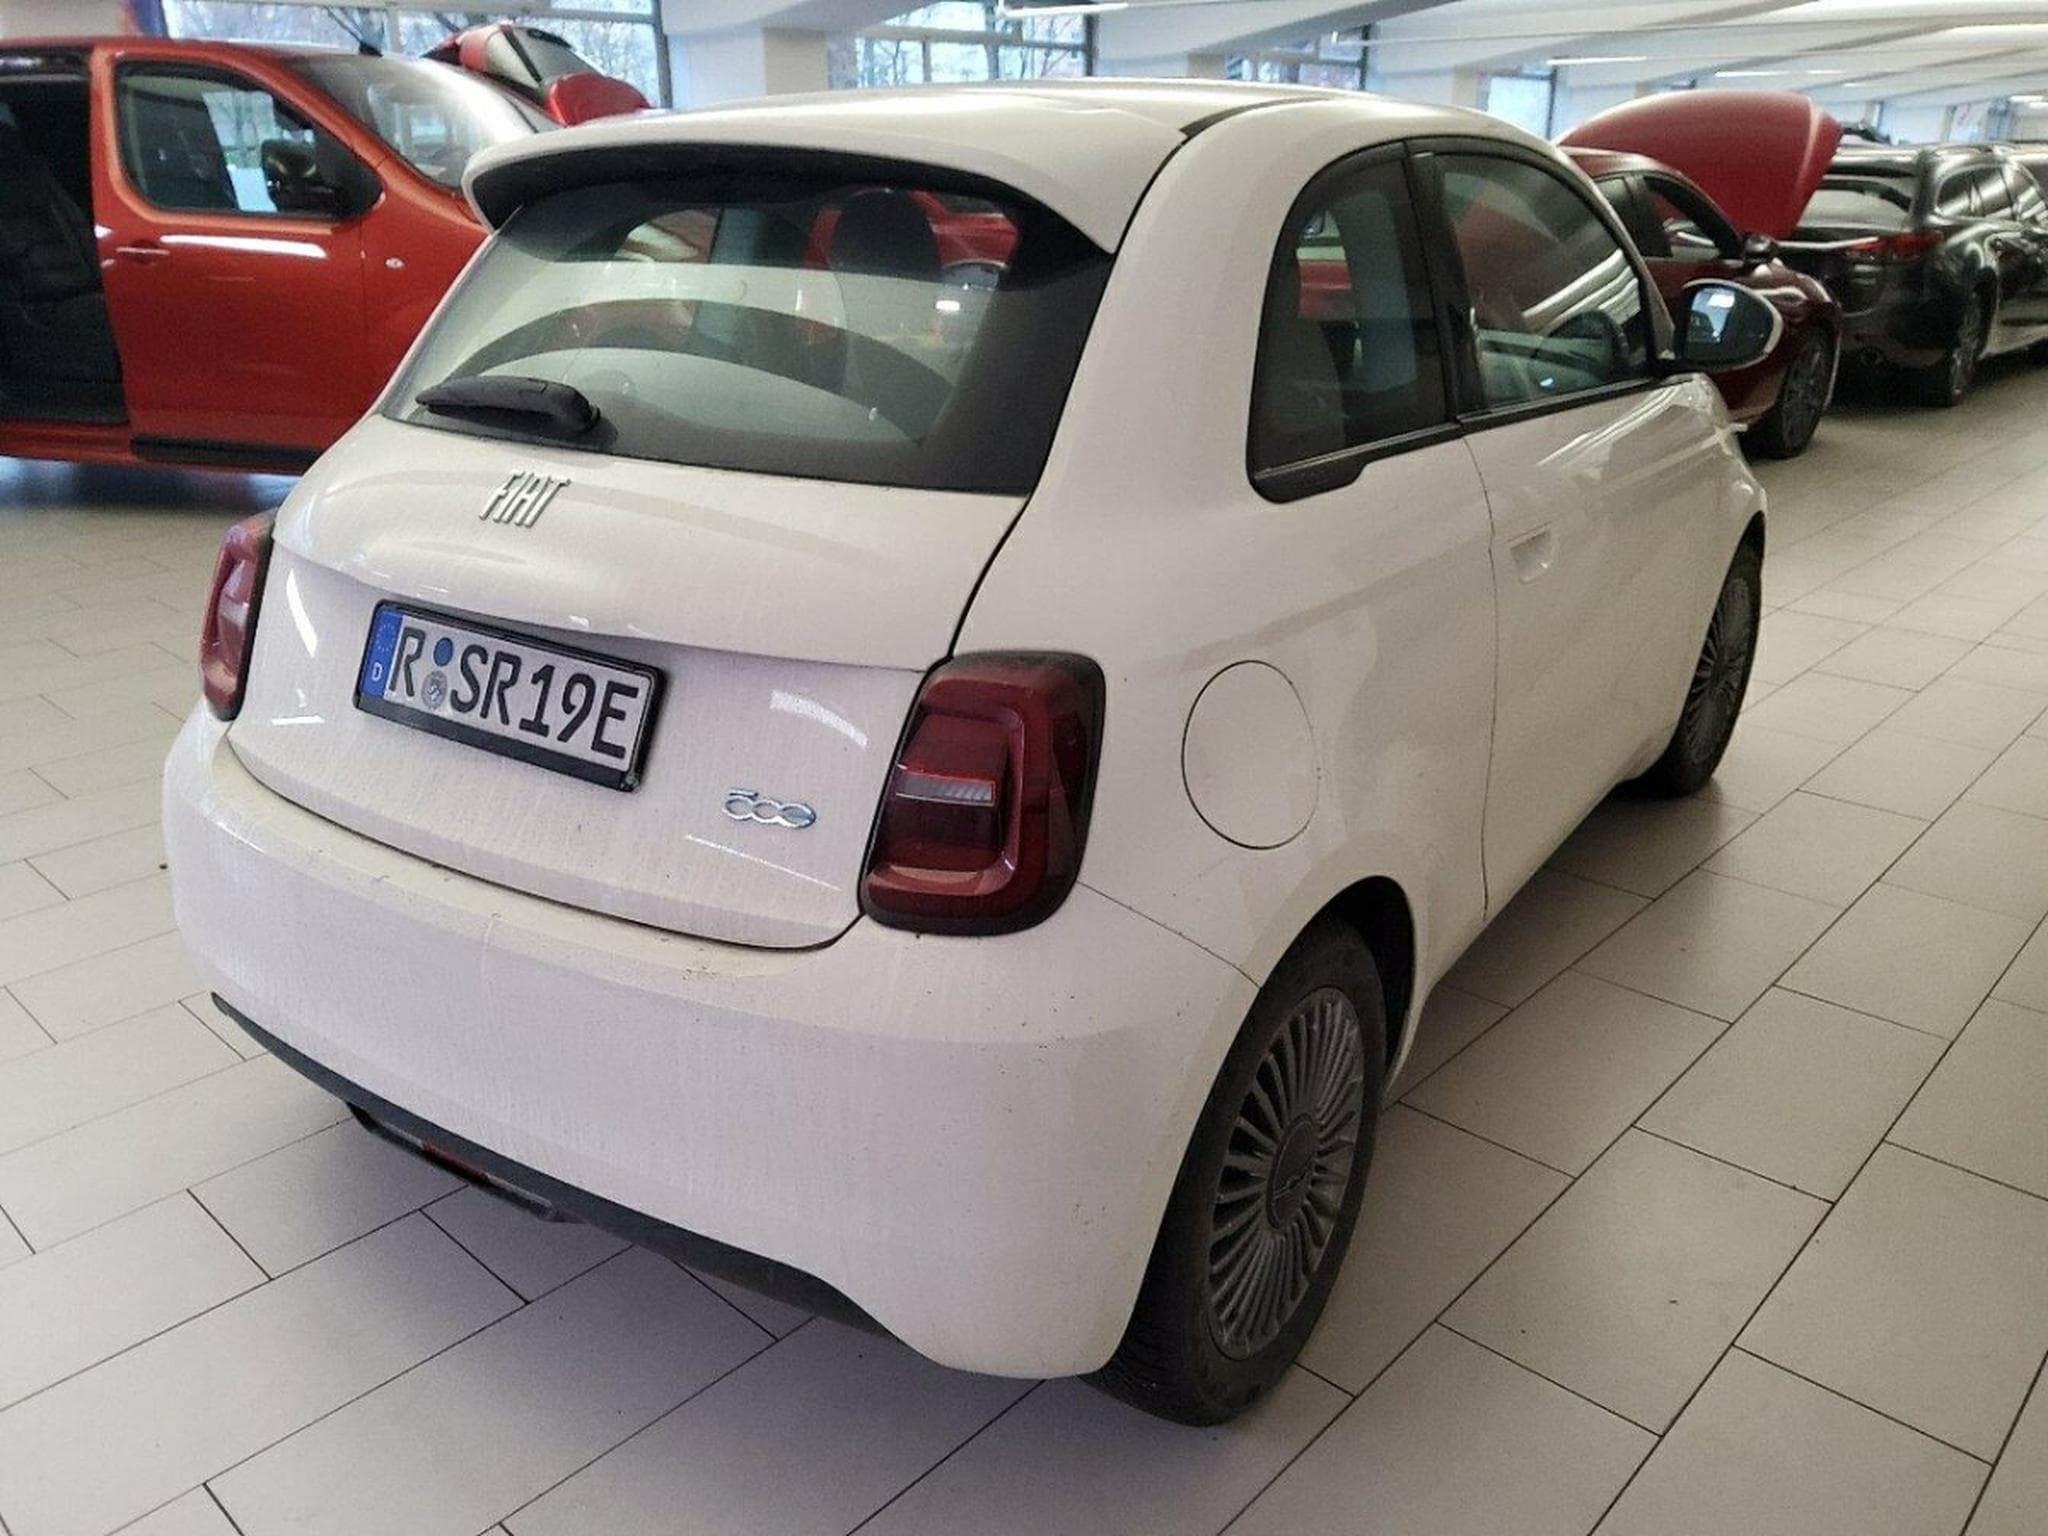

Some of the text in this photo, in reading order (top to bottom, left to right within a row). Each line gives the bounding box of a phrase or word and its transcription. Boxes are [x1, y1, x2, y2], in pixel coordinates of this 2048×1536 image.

[478, 470, 572, 529] FIAT
[371, 661, 383, 682] D
[388, 626, 426, 698] R
[722, 789, 817, 829] 500
